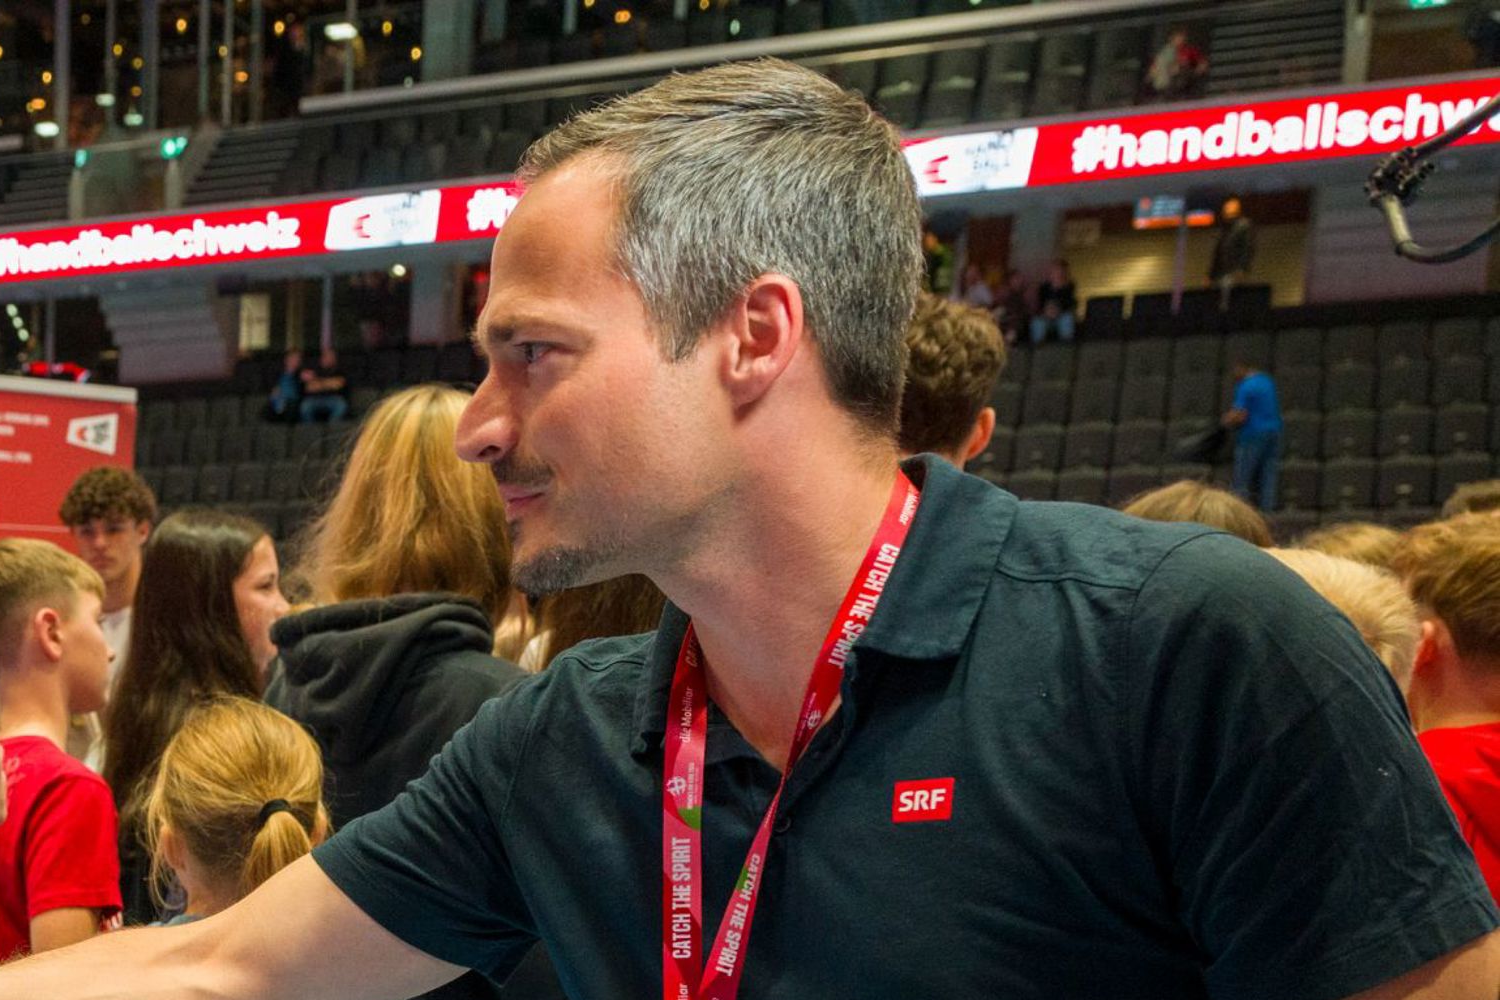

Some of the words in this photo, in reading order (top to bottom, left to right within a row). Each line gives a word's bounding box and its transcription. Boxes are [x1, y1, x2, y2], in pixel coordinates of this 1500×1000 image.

[863, 543, 901, 595] CATCH
[849, 592, 880, 622] THE
[898, 788, 946, 812] SRF
[671, 837, 691, 882] SPIRIT
[740, 853, 761, 901] CATCH
[672, 883, 691, 910] THE
[729, 900, 749, 930] THE
[672, 913, 691, 959] CATCH
[715, 929, 742, 977] SPIRIT
